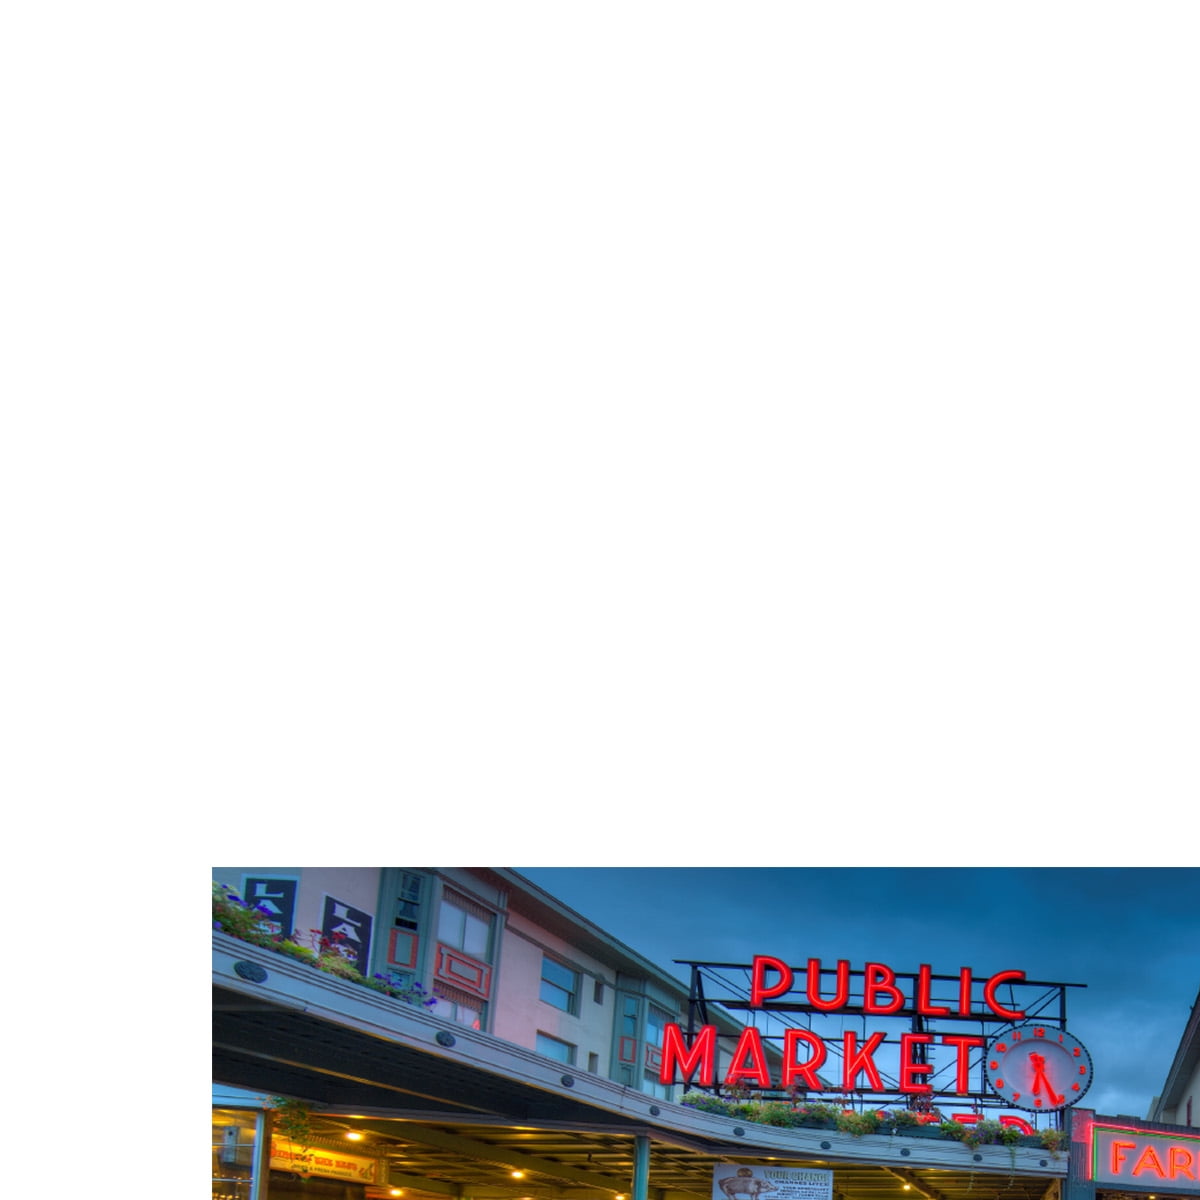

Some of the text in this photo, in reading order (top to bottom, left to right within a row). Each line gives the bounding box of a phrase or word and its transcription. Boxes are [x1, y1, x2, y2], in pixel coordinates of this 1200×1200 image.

[750, 955, 1027, 1020] PUBLIC
[1012, 1031, 1021, 1040] 11
[1033, 1027, 1045, 1037] 12
[1059, 1034, 1064, 1043] 1
[995, 1043, 1007, 1053] 10
[1073, 1047, 1081, 1057] 2
[659, 1022, 985, 1097] MARKET
[990, 1060, 999, 1070] 9
[1078, 1065, 1087, 1075] 3
[995, 1078, 1004, 1089] 8
[1071, 1082, 1080, 1092] 4
[1012, 1092, 1021, 1101] 7
[1034, 1098, 1043, 1108] 6
[764, 1170, 830, 1182] YOUR CHANGE
